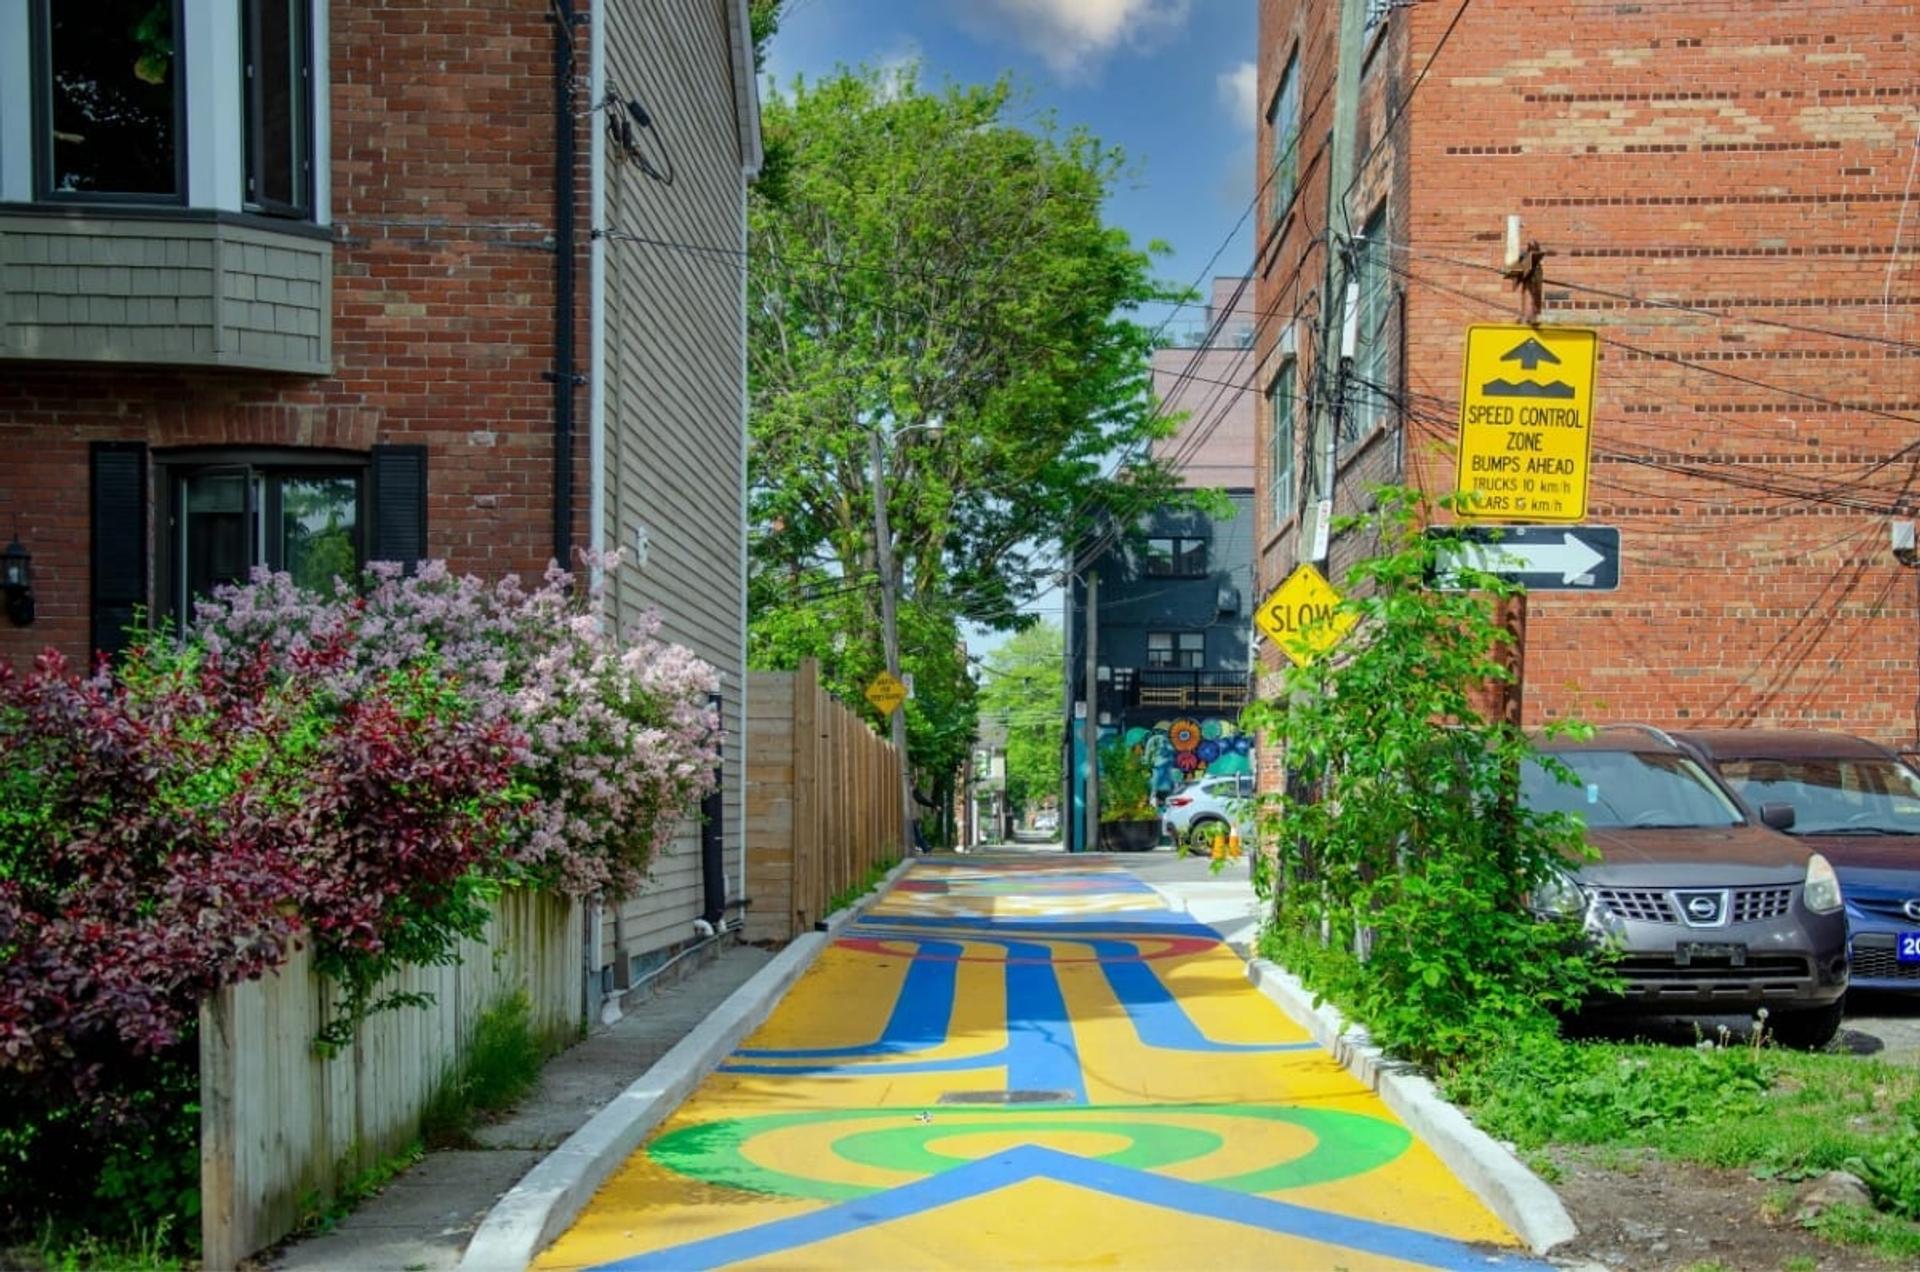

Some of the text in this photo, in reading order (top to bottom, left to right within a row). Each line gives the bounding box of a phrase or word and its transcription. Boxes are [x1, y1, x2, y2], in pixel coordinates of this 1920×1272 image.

[1468, 405, 1584, 428] SPEED CONTROL
[1506, 432, 1544, 452] ZONE
[1472, 455, 1575, 475] BUMPS AHEAD
[1472, 477, 1518, 492] TRUCKS
[1523, 479, 1535, 492] 10
[1270, 603, 1337, 633] SLOW
